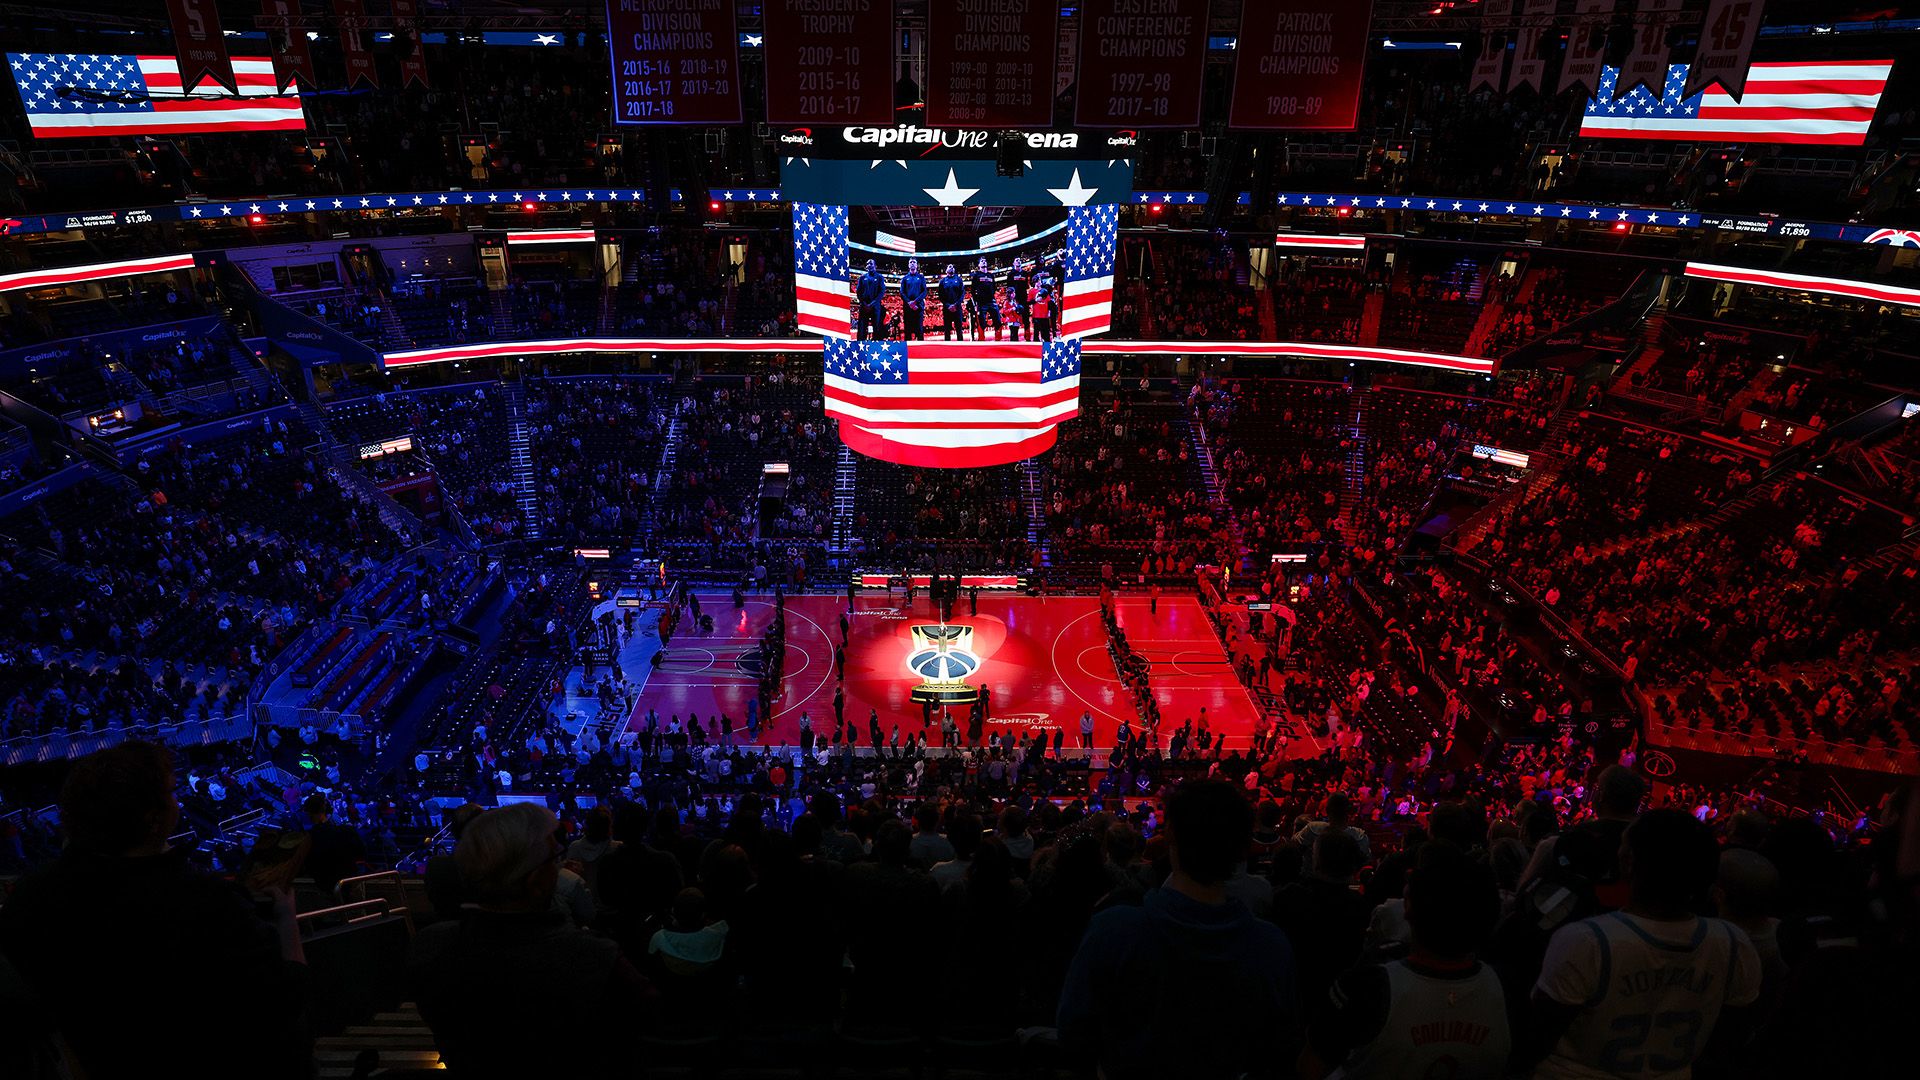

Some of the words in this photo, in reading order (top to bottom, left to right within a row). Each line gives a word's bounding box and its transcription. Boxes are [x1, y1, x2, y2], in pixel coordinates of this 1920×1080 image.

[1113, 0, 1178, 14] EASTERN
[642, 12, 702, 31] DIVISION
[801, 14, 855, 34] TROPHY
[965, 14, 1021, 32] DIVISION
[1097, 16, 1192, 36] CONFERENCE
[1276, 12, 1333, 32] PATRICK
[1711, 2, 1752, 50] 45
[633, 32, 713, 51] CHAMPIONS
[955, 33, 1031, 52] CHAMPIONS
[1100, 38, 1187, 57] CHAMPIONS
[1272, 34, 1333, 53] DIVISION
[798, 46, 860, 66] 2009-10
[1260, 55, 1340, 75] CHAMPIONS
[623, 60, 671, 76] 2015-16
[680, 59, 728, 75] 2018-19
[625, 80, 672, 96] 2016-17
[682, 80, 729, 95] 2019-20
[799, 71, 860, 91] 2015-16
[1111, 73, 1171, 93] 1997-98
[626, 101, 674, 116] 2017-18
[800, 95, 860, 115] 2016-17
[1107, 97, 1170, 116] 2017-18
[1266, 96, 1323, 115] 1988-89
[993, 131, 1079, 148] ena
[125, 214, 152, 224] $1,890
[1779, 227, 1810, 236] $1,890
[1600, 1009, 1704, 1072] 23
